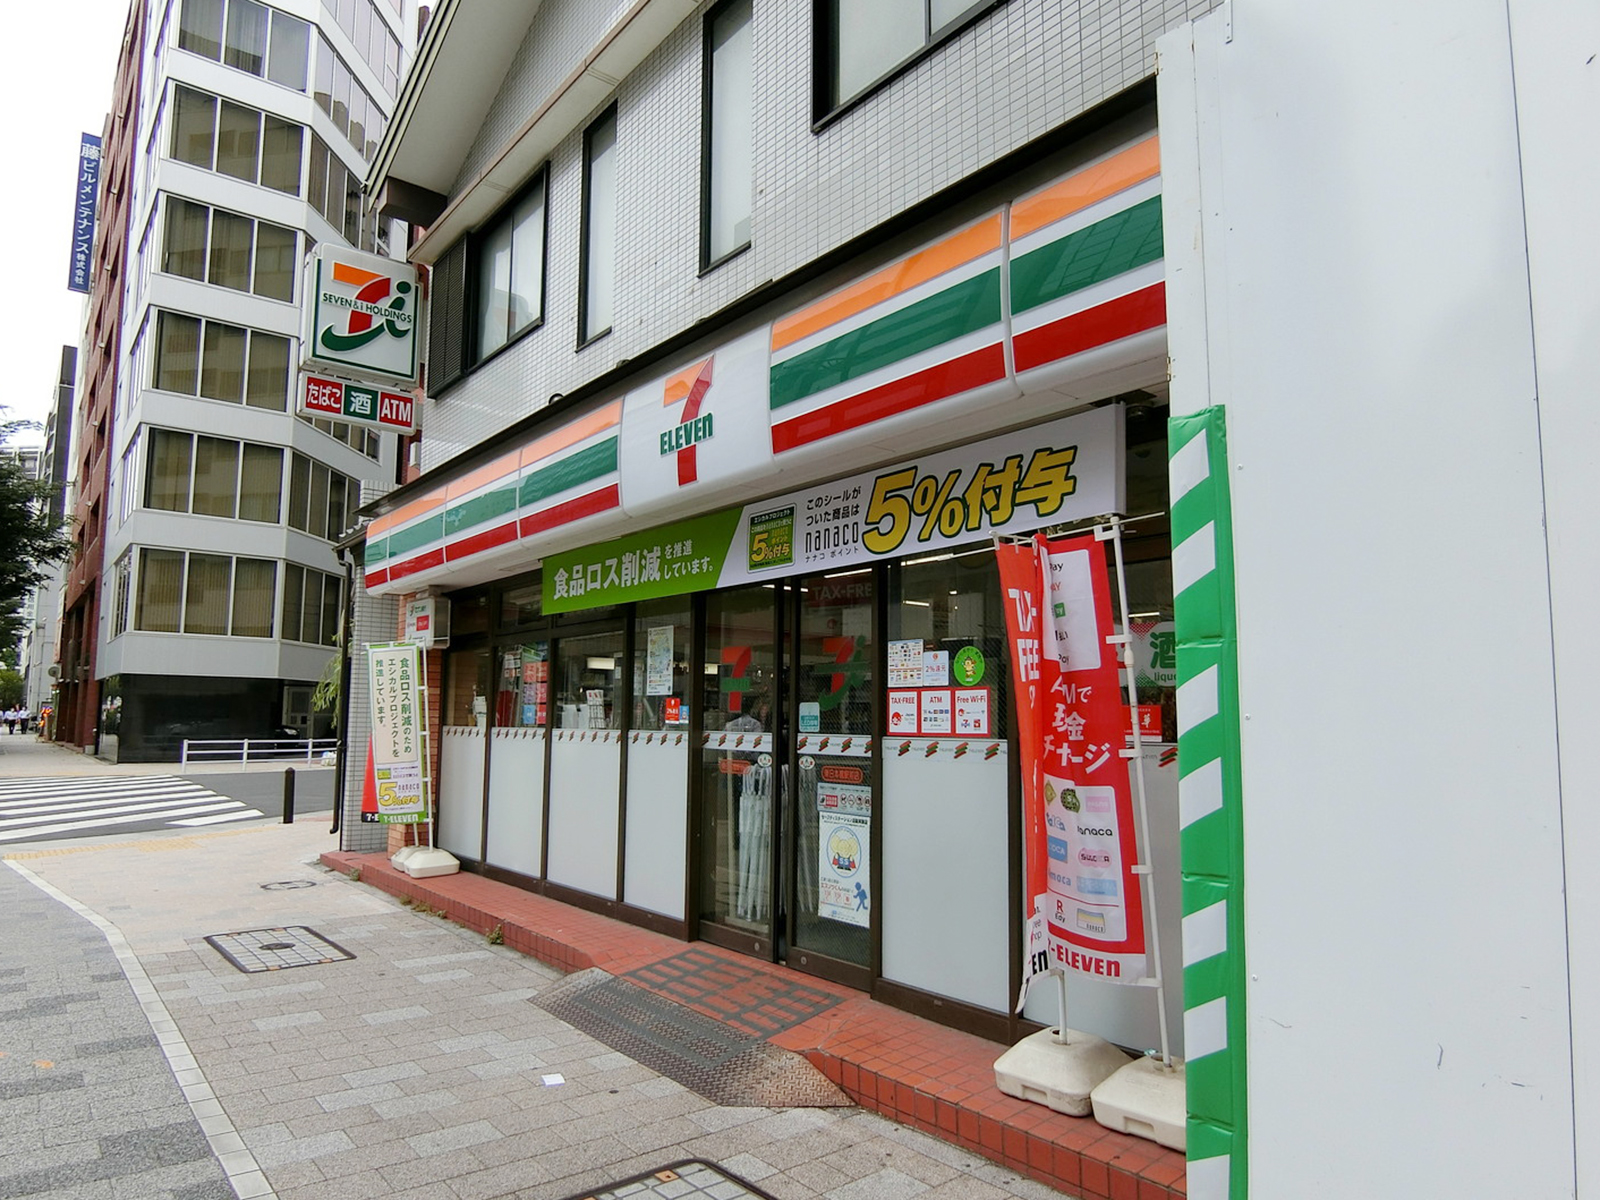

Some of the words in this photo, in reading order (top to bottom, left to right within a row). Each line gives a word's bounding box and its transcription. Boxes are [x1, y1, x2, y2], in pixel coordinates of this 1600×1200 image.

[75, 142, 100, 285] 藤ビルメンテナンス株式会社
[365, 304, 412, 324] HOLDINGS
[307, 382, 341, 409] たばこ
[349, 391, 373, 415] 酒
[380, 397, 411, 423] ATM
[806, 485, 862, 511] このシールが
[862, 445, 1078, 555] 5%付与
[805, 503, 860, 527] ついた商品は
[664, 540, 692, 560] を推進
[805, 521, 859, 554] nanaco
[805, 552, 826, 563] ナナコ
[830, 545, 859, 559] ポイント
[1050, 562, 1064, 572] ay
[553, 545, 661, 600] 食品ロス削減
[663, 555, 714, 580] しています。
[1150, 631, 1177, 669] 酒
[375, 659, 387, 728] 推進しています。
[929, 696, 943, 704] ATM
[956, 696, 969, 704] Free
[1050, 674, 1092, 705] AMで
[387, 658, 401, 759] エシカルプロジェクトを
[399, 657, 413, 755] 食品ロス削減のため
[1077, 825, 1113, 837] anaca
